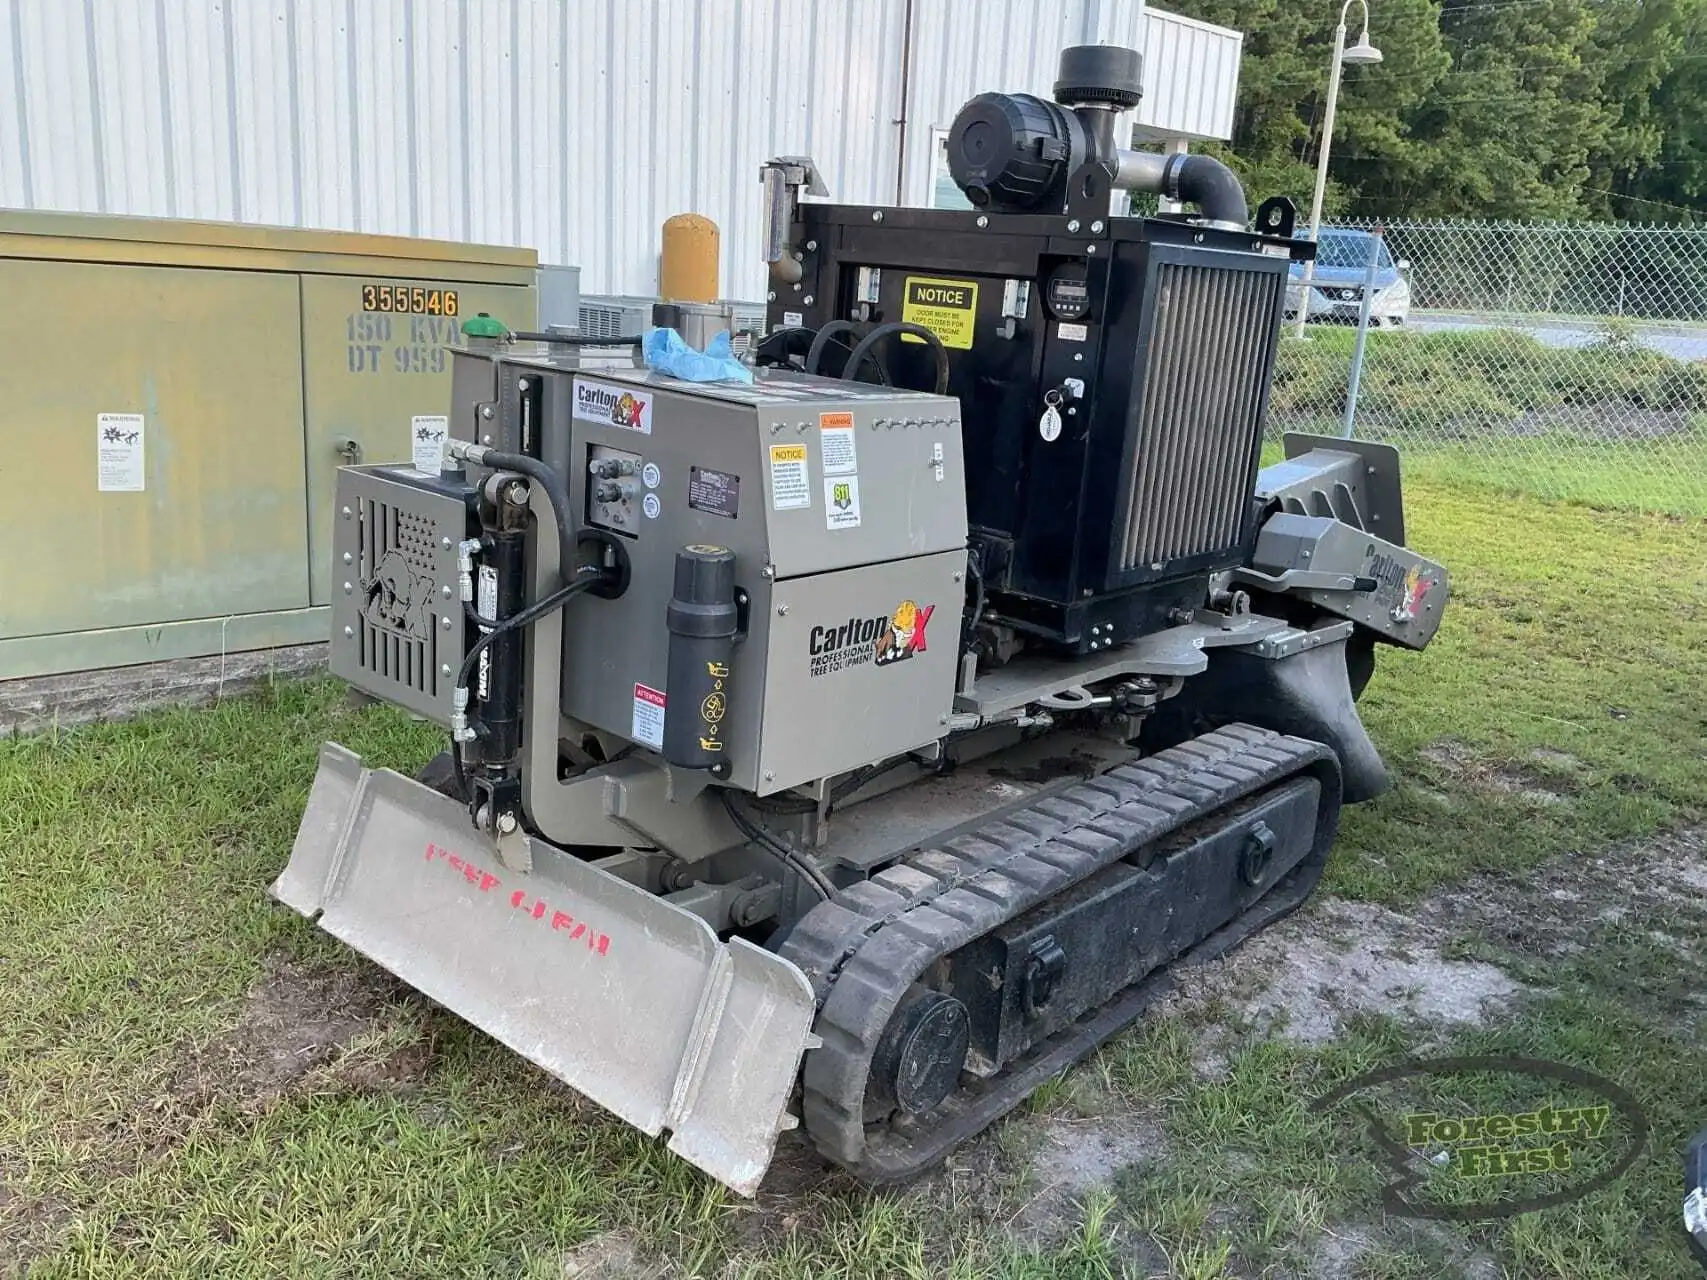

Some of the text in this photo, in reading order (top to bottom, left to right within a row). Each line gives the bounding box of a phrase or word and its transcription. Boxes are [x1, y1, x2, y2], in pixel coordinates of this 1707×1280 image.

[363, 286, 457, 315] 355546
[917, 287, 964, 304] NOTICE
[346, 314, 461, 345] 150 KVA
[348, 345, 445, 373] DT 959
[578, 385, 618, 409] Carlton
[775, 450, 802, 460] NOTICE
[809, 605, 936, 655] Carlton X
[810, 644, 874, 667] PROFESSIONAL
[810, 667, 827, 678] TREE
